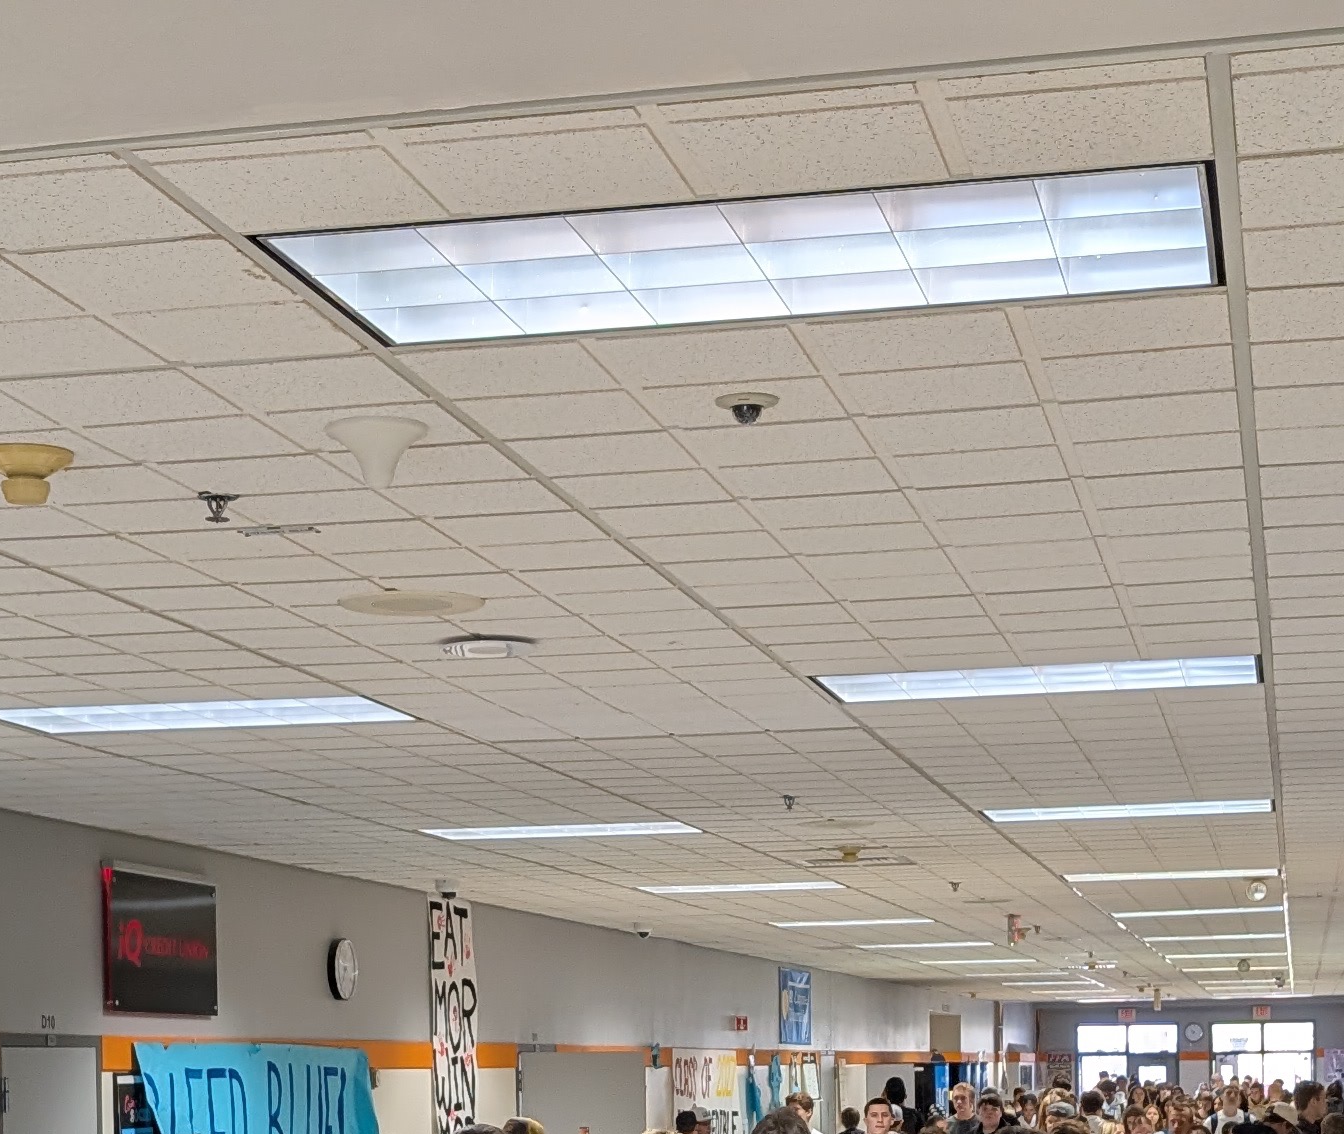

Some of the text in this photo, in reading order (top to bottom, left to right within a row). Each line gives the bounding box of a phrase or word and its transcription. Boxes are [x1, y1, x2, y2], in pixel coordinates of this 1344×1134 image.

[430, 900, 468, 970] EAT
[434, 978, 478, 1054] MOR
[433, 1047, 476, 1120] WIN
